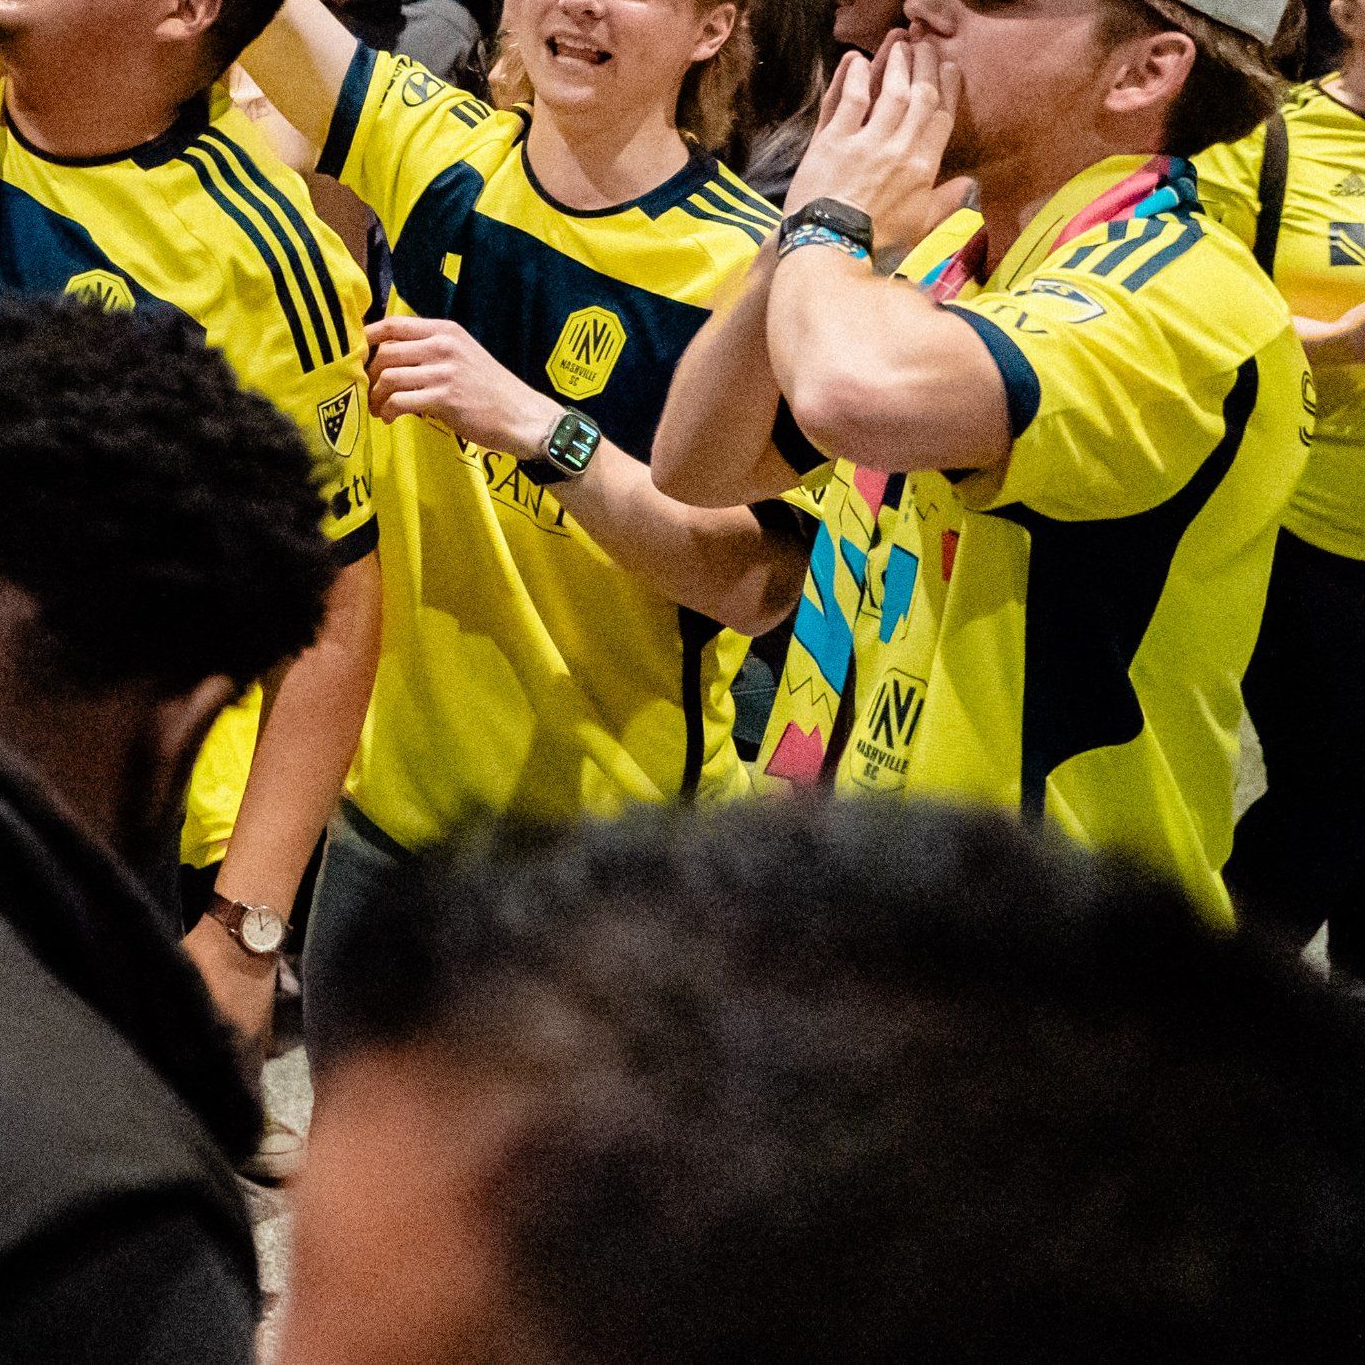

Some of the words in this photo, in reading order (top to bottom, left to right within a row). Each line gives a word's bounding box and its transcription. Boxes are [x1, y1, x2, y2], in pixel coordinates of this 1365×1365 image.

[560, 358, 598, 383] NASHVILLE
[568, 375, 579, 387] SC
[323, 399, 346, 421] MLS
